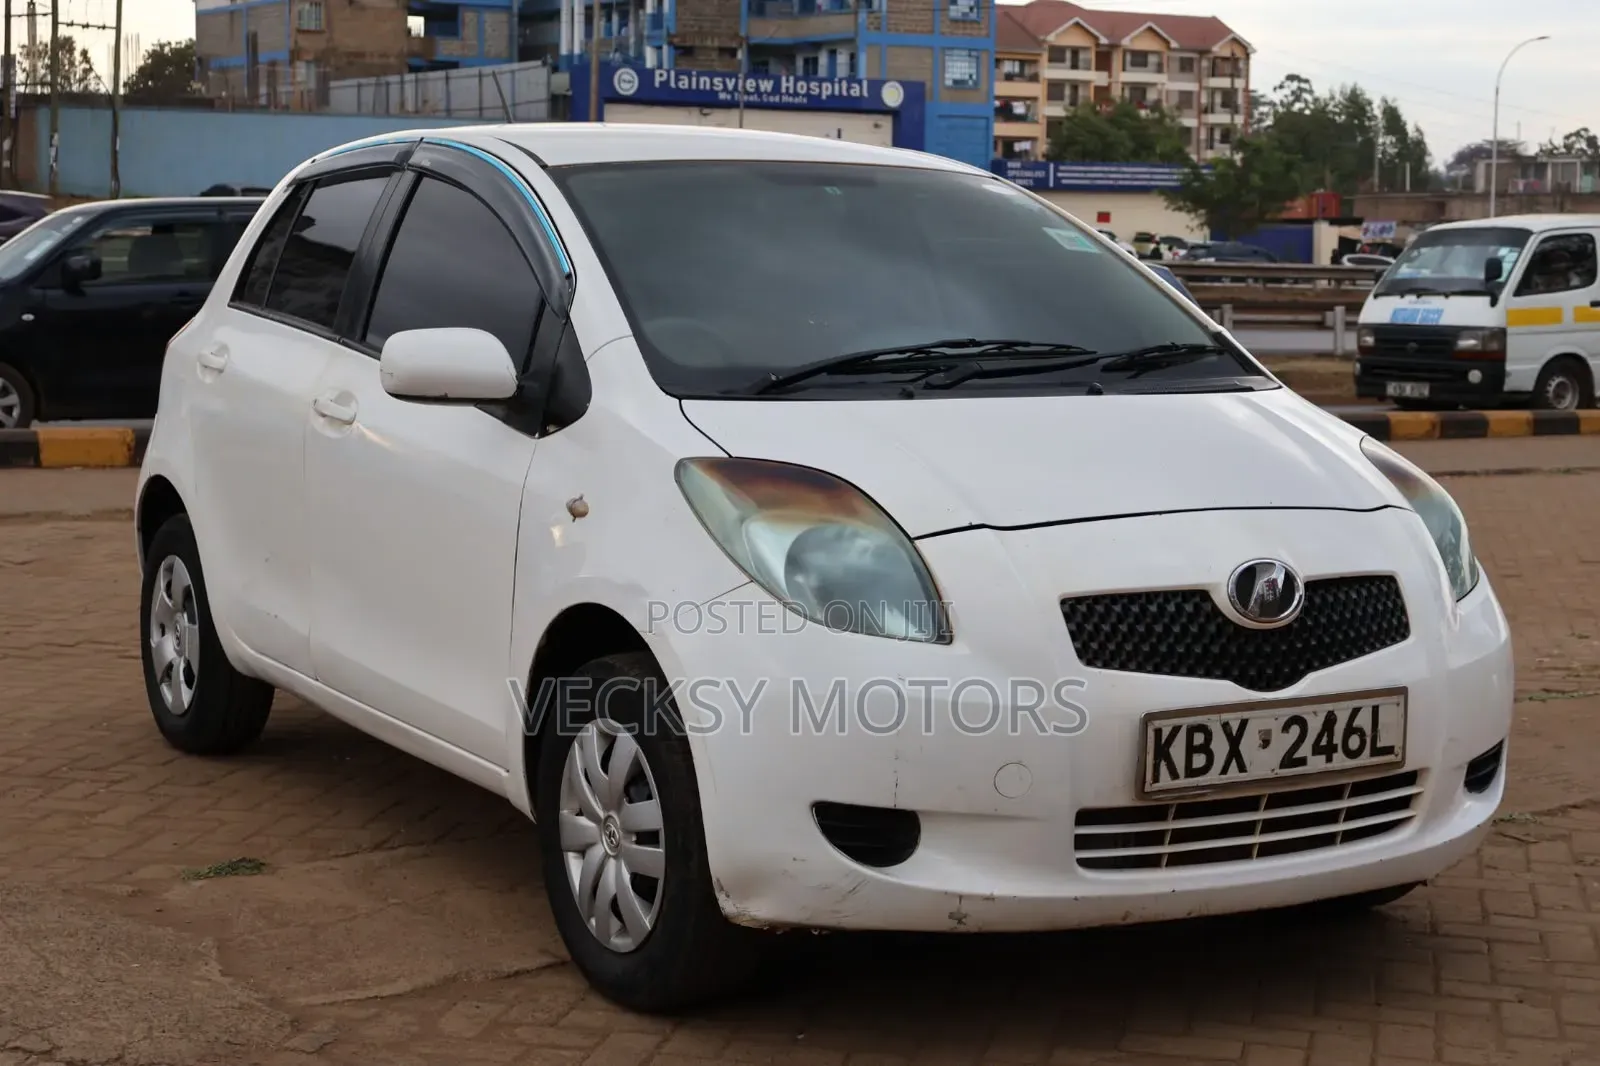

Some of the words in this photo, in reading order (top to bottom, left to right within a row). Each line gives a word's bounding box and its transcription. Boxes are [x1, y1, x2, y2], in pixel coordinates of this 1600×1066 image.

[654, 69, 774, 93] Plainsview
[781, 75, 869, 100] Hospital
[1152, 718, 1249, 784] KBX
[1279, 704, 1396, 769] 246L
